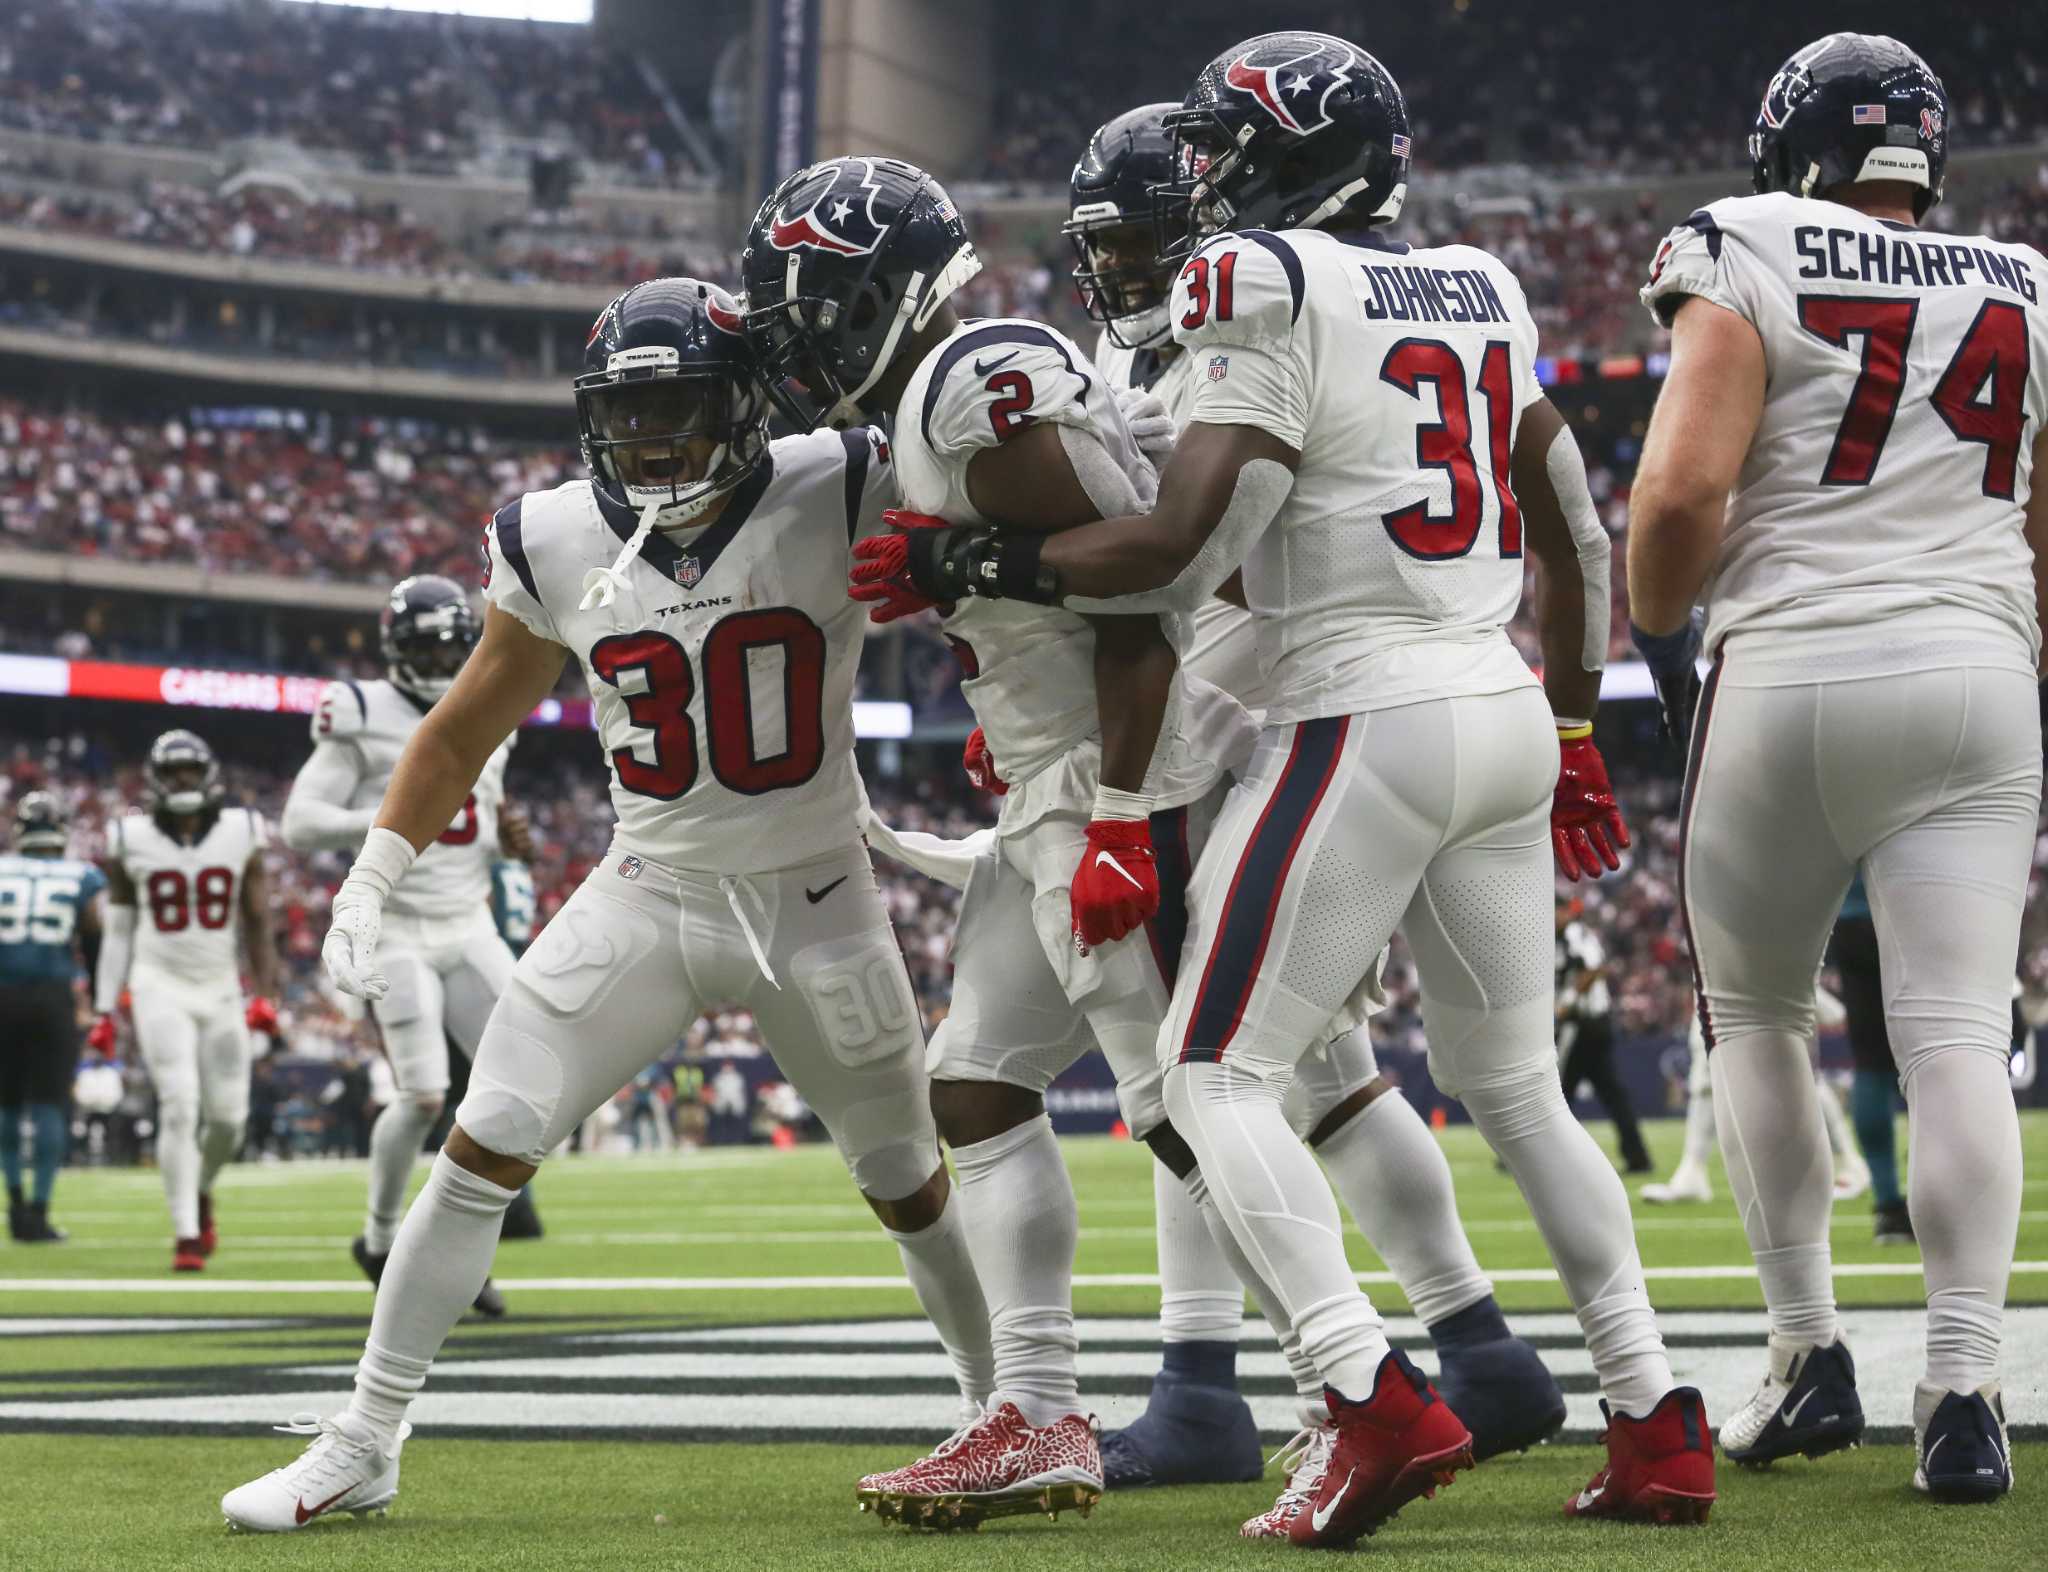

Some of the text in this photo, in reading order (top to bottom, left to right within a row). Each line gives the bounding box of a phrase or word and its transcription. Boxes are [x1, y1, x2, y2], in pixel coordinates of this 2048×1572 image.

[1180, 252, 1239, 331] 31
[1361, 264, 1511, 323] JOHNSON
[1795, 225, 2038, 306] SCHARPING
[985, 369, 1037, 444] 2
[1797, 293, 2031, 502] 74
[1379, 337, 1523, 562] 31
[655, 596, 732, 618] TEXANS
[589, 606, 827, 802] 30
[0, 876, 80, 945] 95
[147, 866, 234, 934] 88
[821, 958, 914, 1048] 30
